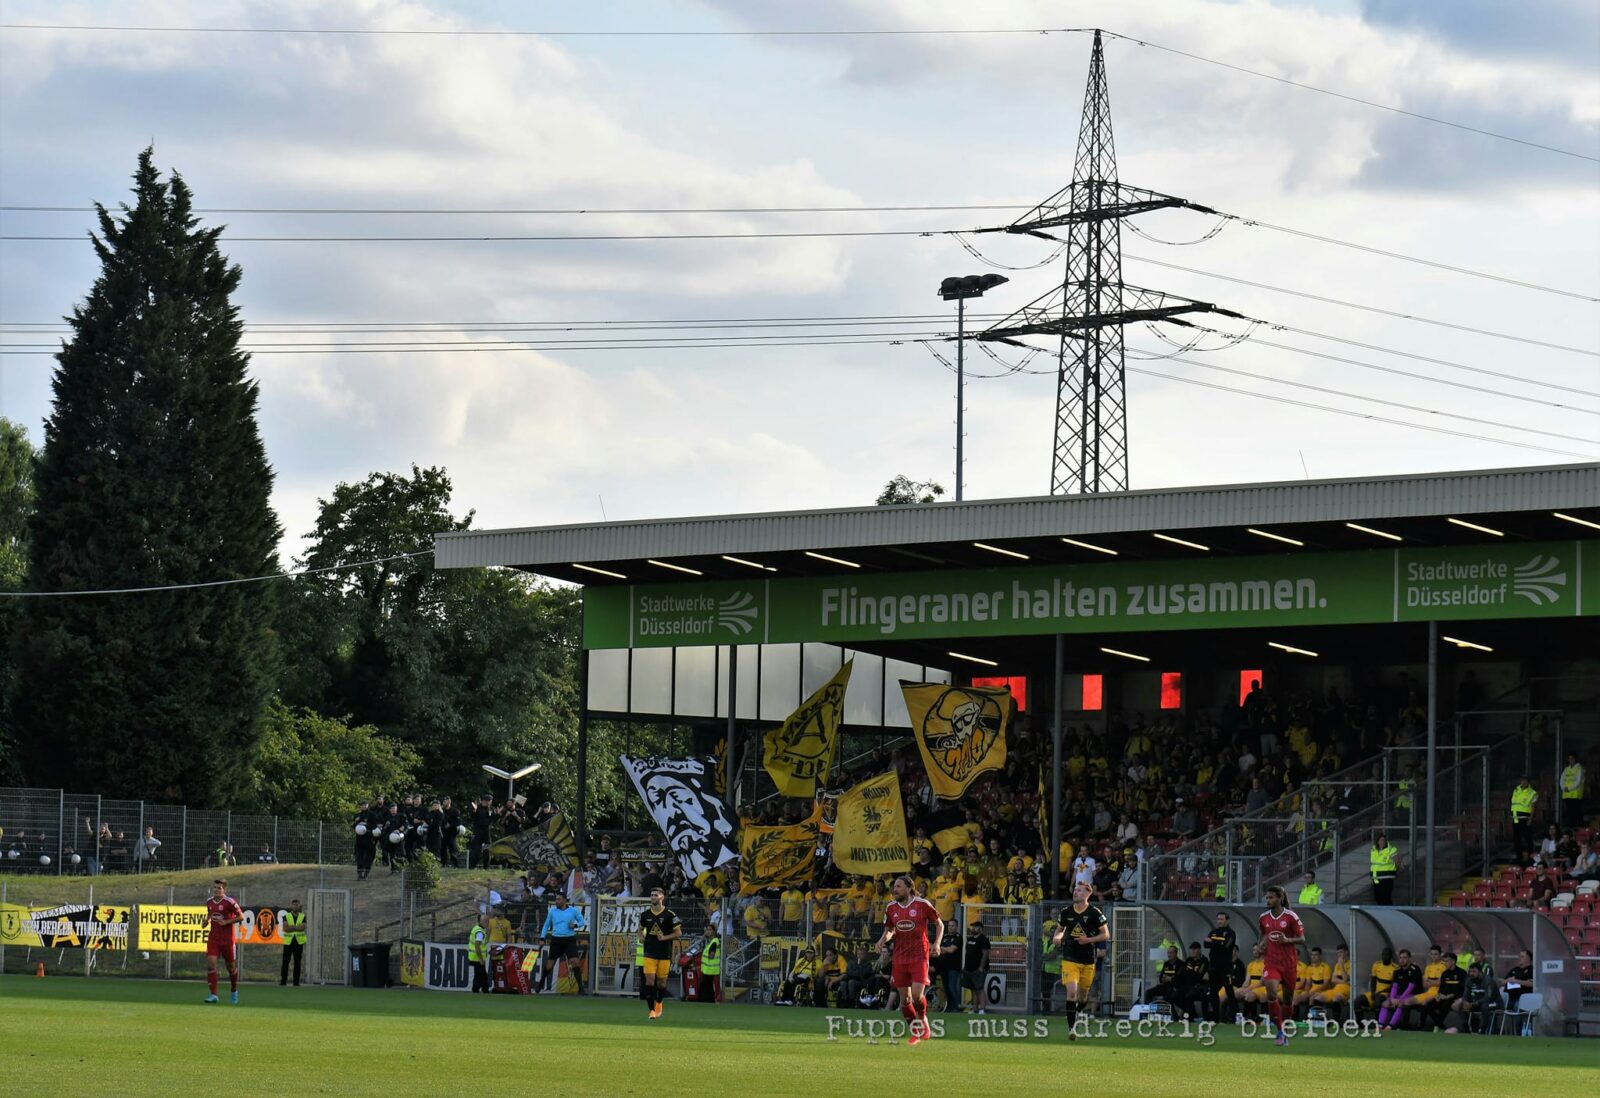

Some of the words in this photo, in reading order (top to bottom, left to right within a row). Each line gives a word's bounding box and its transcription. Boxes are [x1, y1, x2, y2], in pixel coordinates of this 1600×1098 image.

[1407, 559, 1508, 581] Stadtwerke
[639, 594, 715, 613] Stadtwerke
[821, 587, 1005, 634] Flingeraner
[1012, 578, 1117, 620] halten
[1126, 577, 1328, 616] zusammen.
[1407, 583, 1508, 607] Düsseldorf
[639, 615, 715, 636] Düsseldorf
[141, 910, 207, 925] HÜRTGENW
[152, 928, 209, 943] RUREIFE
[429, 946, 470, 988] BAD
[618, 963, 631, 990] 7
[986, 975, 1002, 1005] 6
